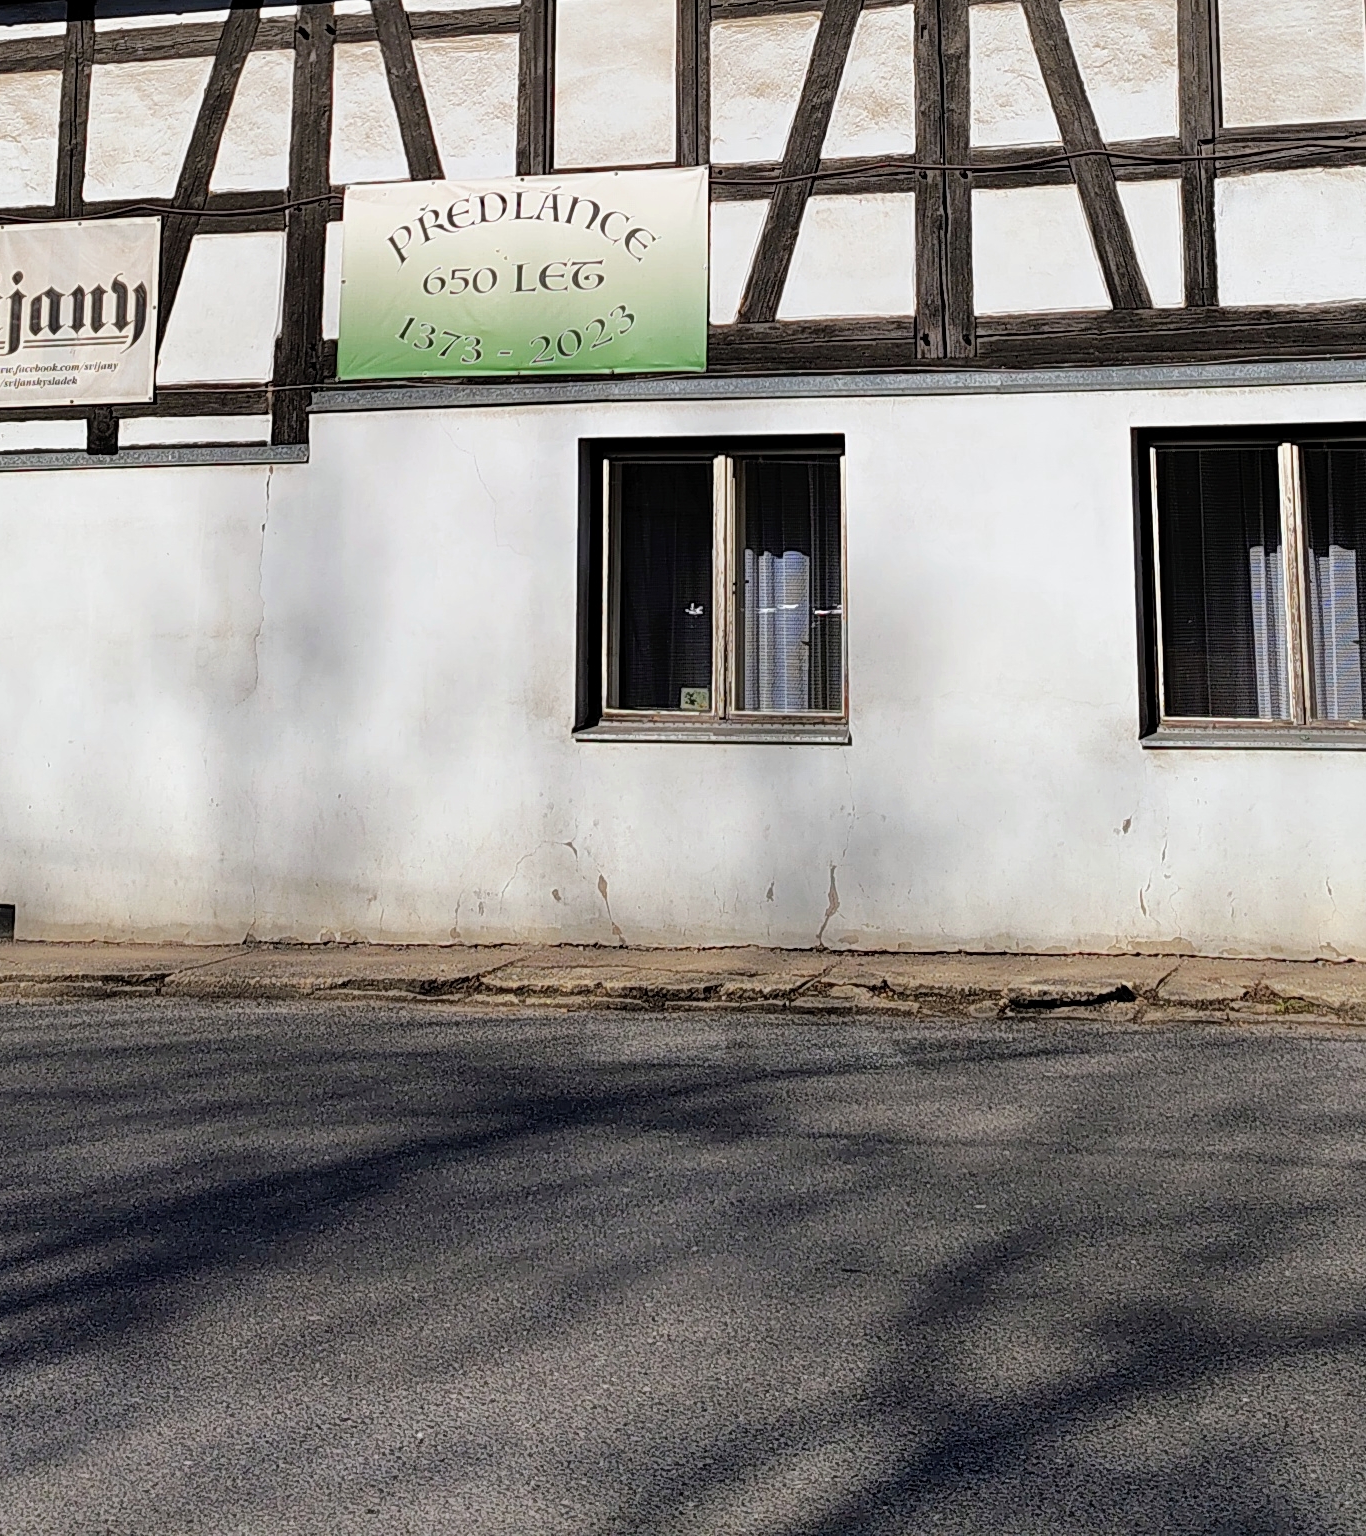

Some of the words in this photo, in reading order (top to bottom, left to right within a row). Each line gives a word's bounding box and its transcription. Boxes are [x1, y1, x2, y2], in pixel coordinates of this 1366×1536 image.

[385, 185, 662, 272] PŘEDLÁNCE
[422, 266, 498, 295] 650
[510, 257, 605, 293] LET
[394, 314, 483, 364] 1373
[529, 303, 636, 365] 2023
